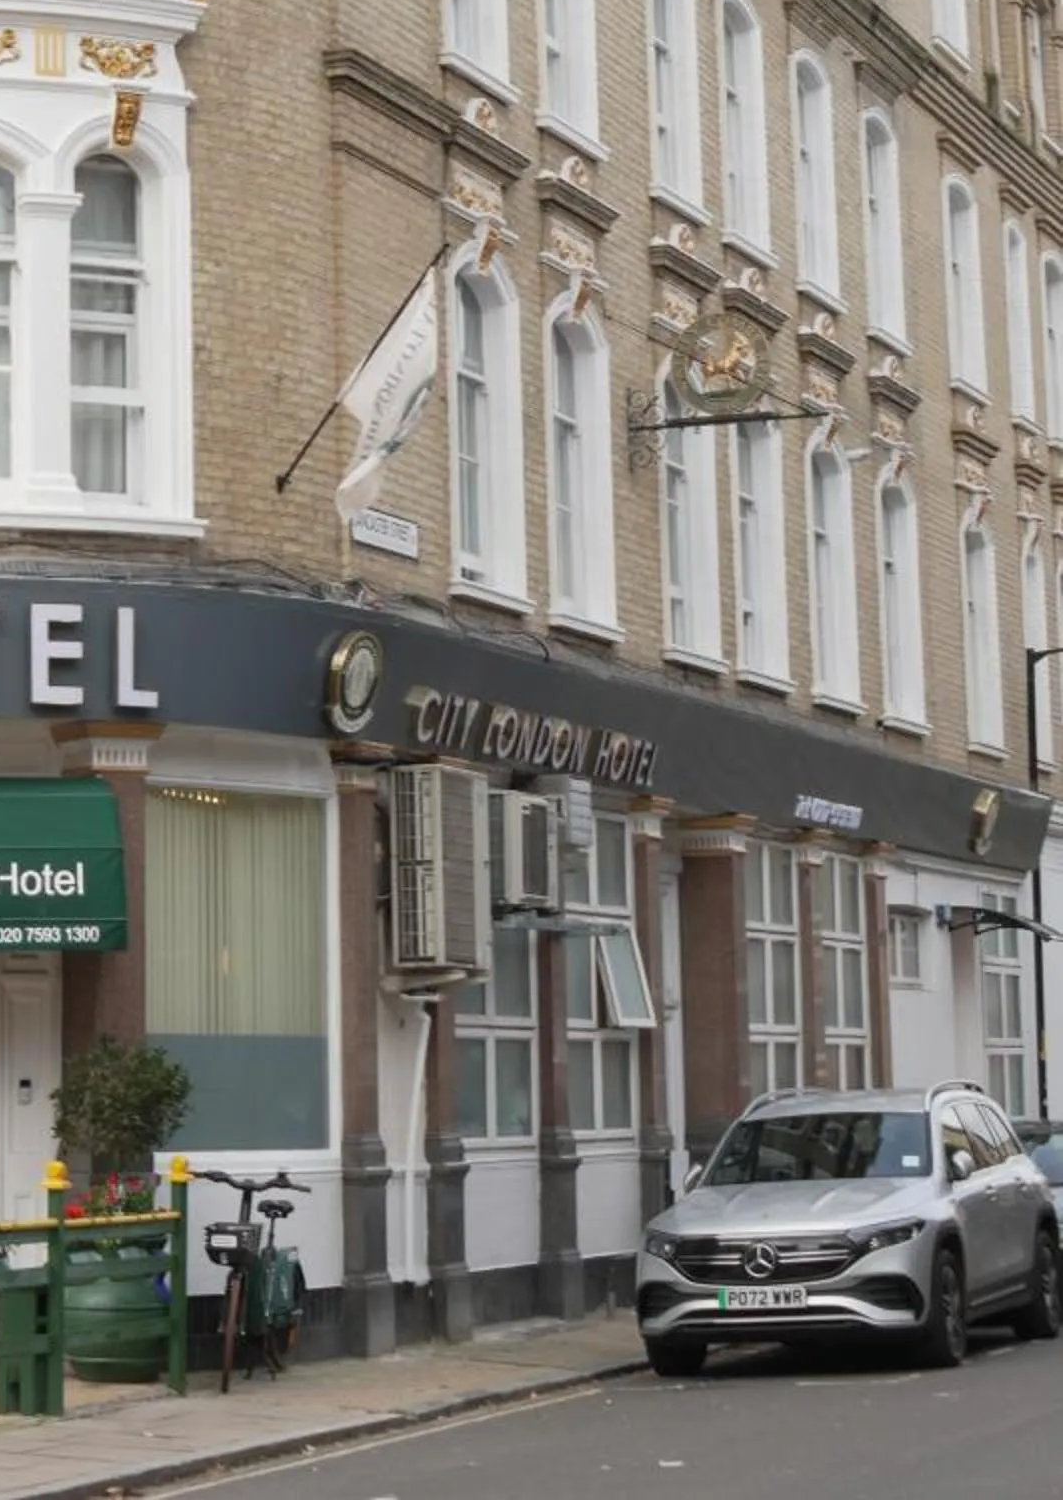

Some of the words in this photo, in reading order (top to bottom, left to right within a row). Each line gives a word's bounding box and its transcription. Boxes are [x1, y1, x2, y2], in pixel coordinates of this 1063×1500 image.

[418, 690, 479, 749] CITY
[483, 707, 592, 773] LONDON
[594, 729, 659, 787] HOTEL
[26, 927, 61, 942] 7593
[66, 926, 100, 942] 1300
